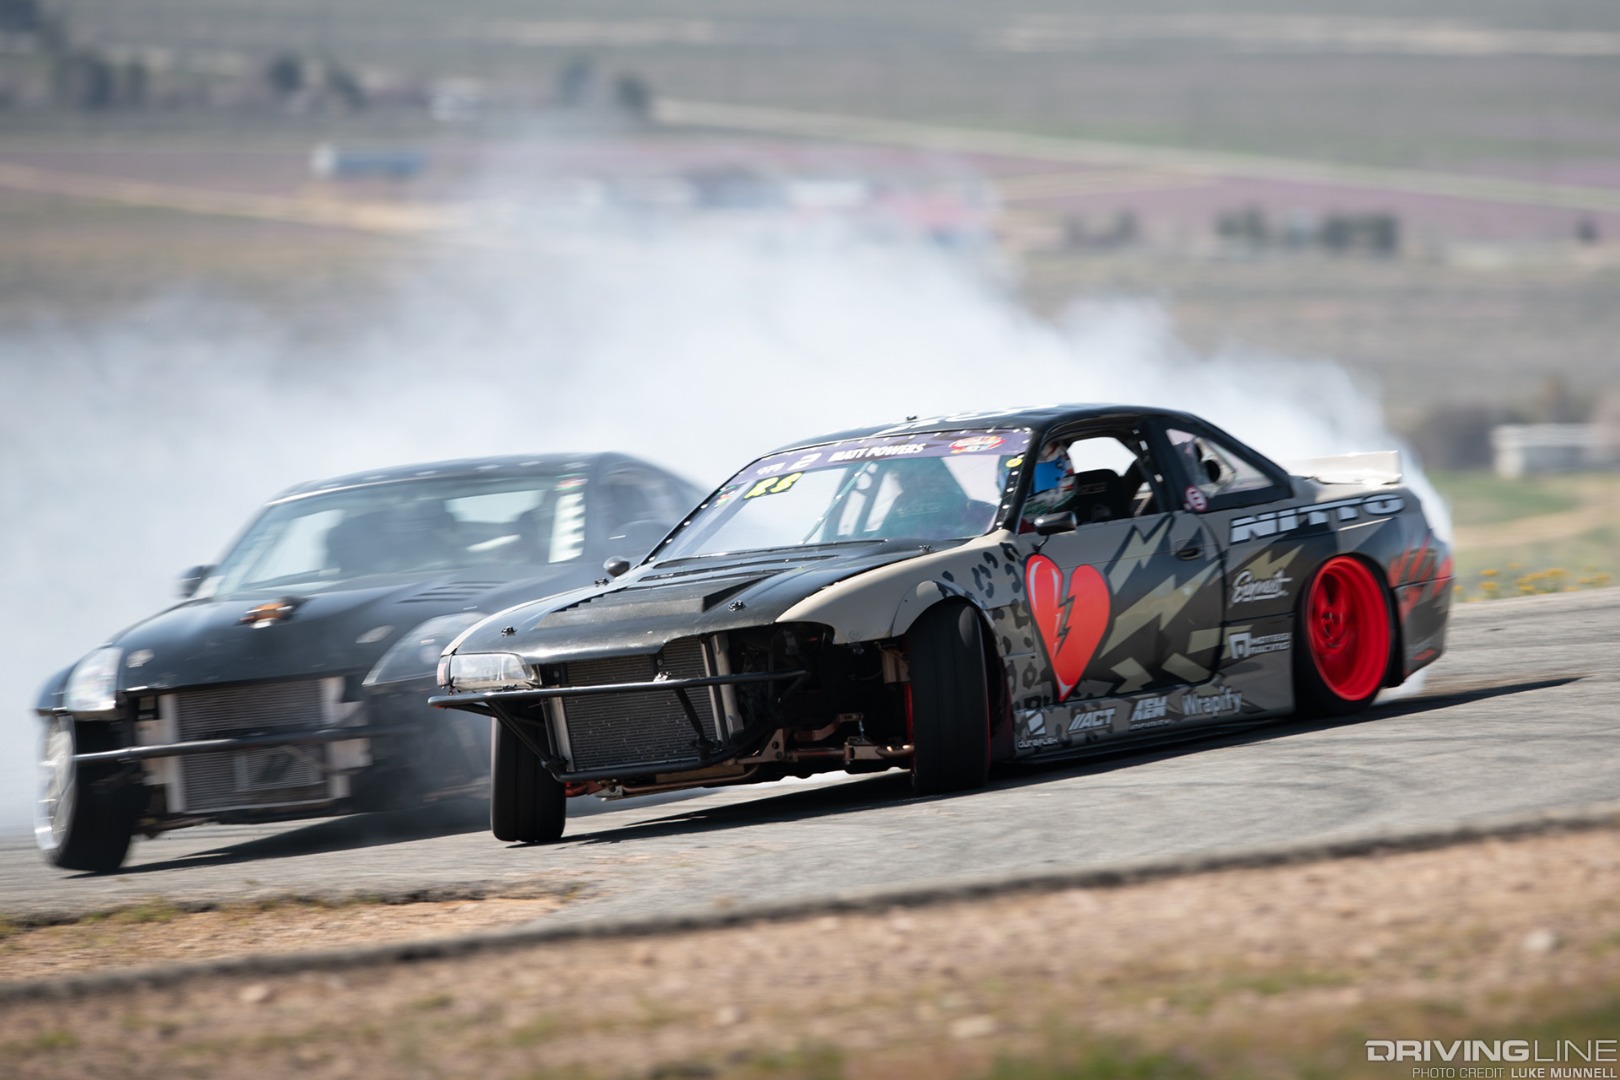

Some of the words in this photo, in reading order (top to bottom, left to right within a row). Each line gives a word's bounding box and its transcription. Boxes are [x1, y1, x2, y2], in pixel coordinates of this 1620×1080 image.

[827, 446, 865, 463] MATT
[865, 443, 926, 458] POWERS
[1230, 493, 1404, 545] NITTO
[1181, 685, 1242, 719] Wrapify
